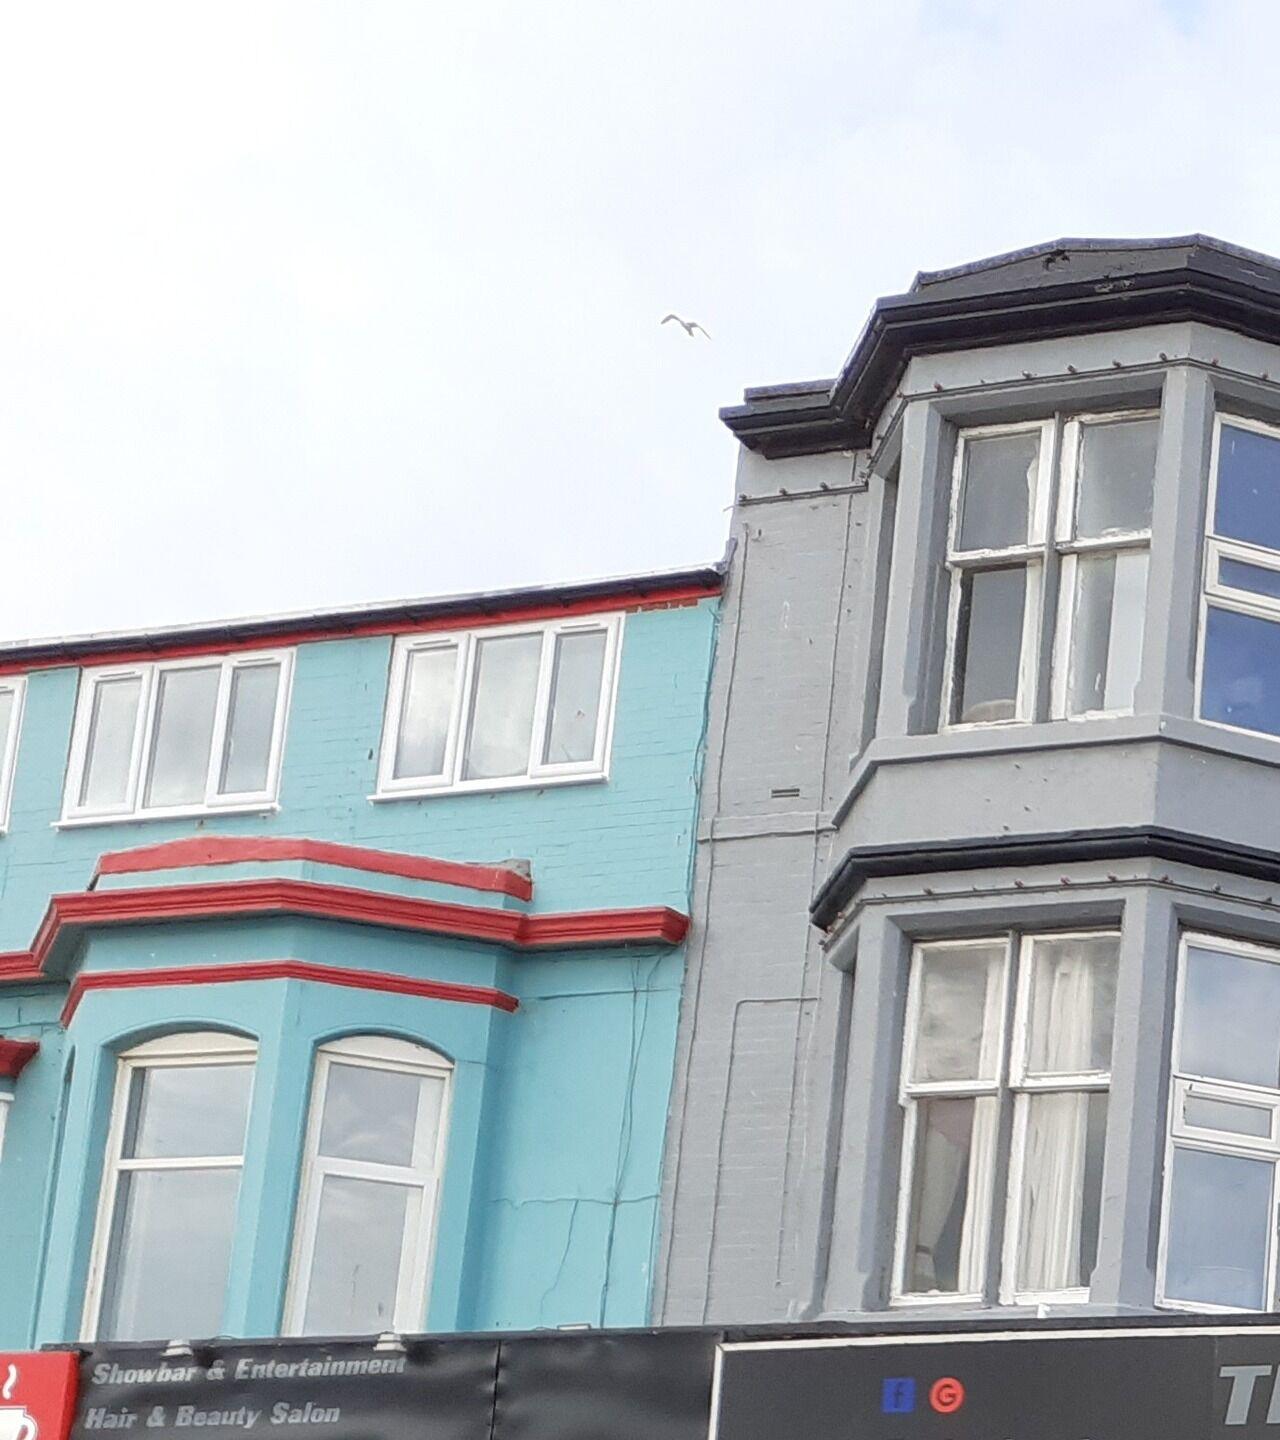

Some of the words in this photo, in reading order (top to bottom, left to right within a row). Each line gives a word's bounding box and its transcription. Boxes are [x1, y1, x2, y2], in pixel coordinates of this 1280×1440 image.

[92, 1360, 196, 1385] Showbar
[208, 1359, 225, 1381] &
[234, 1357, 406, 1380] Entertainment
[85, 1405, 136, 1429] Hair
[148, 1404, 165, 1426] &
[176, 1404, 260, 1430] Beauty
[271, 1402, 340, 1425] Salon
